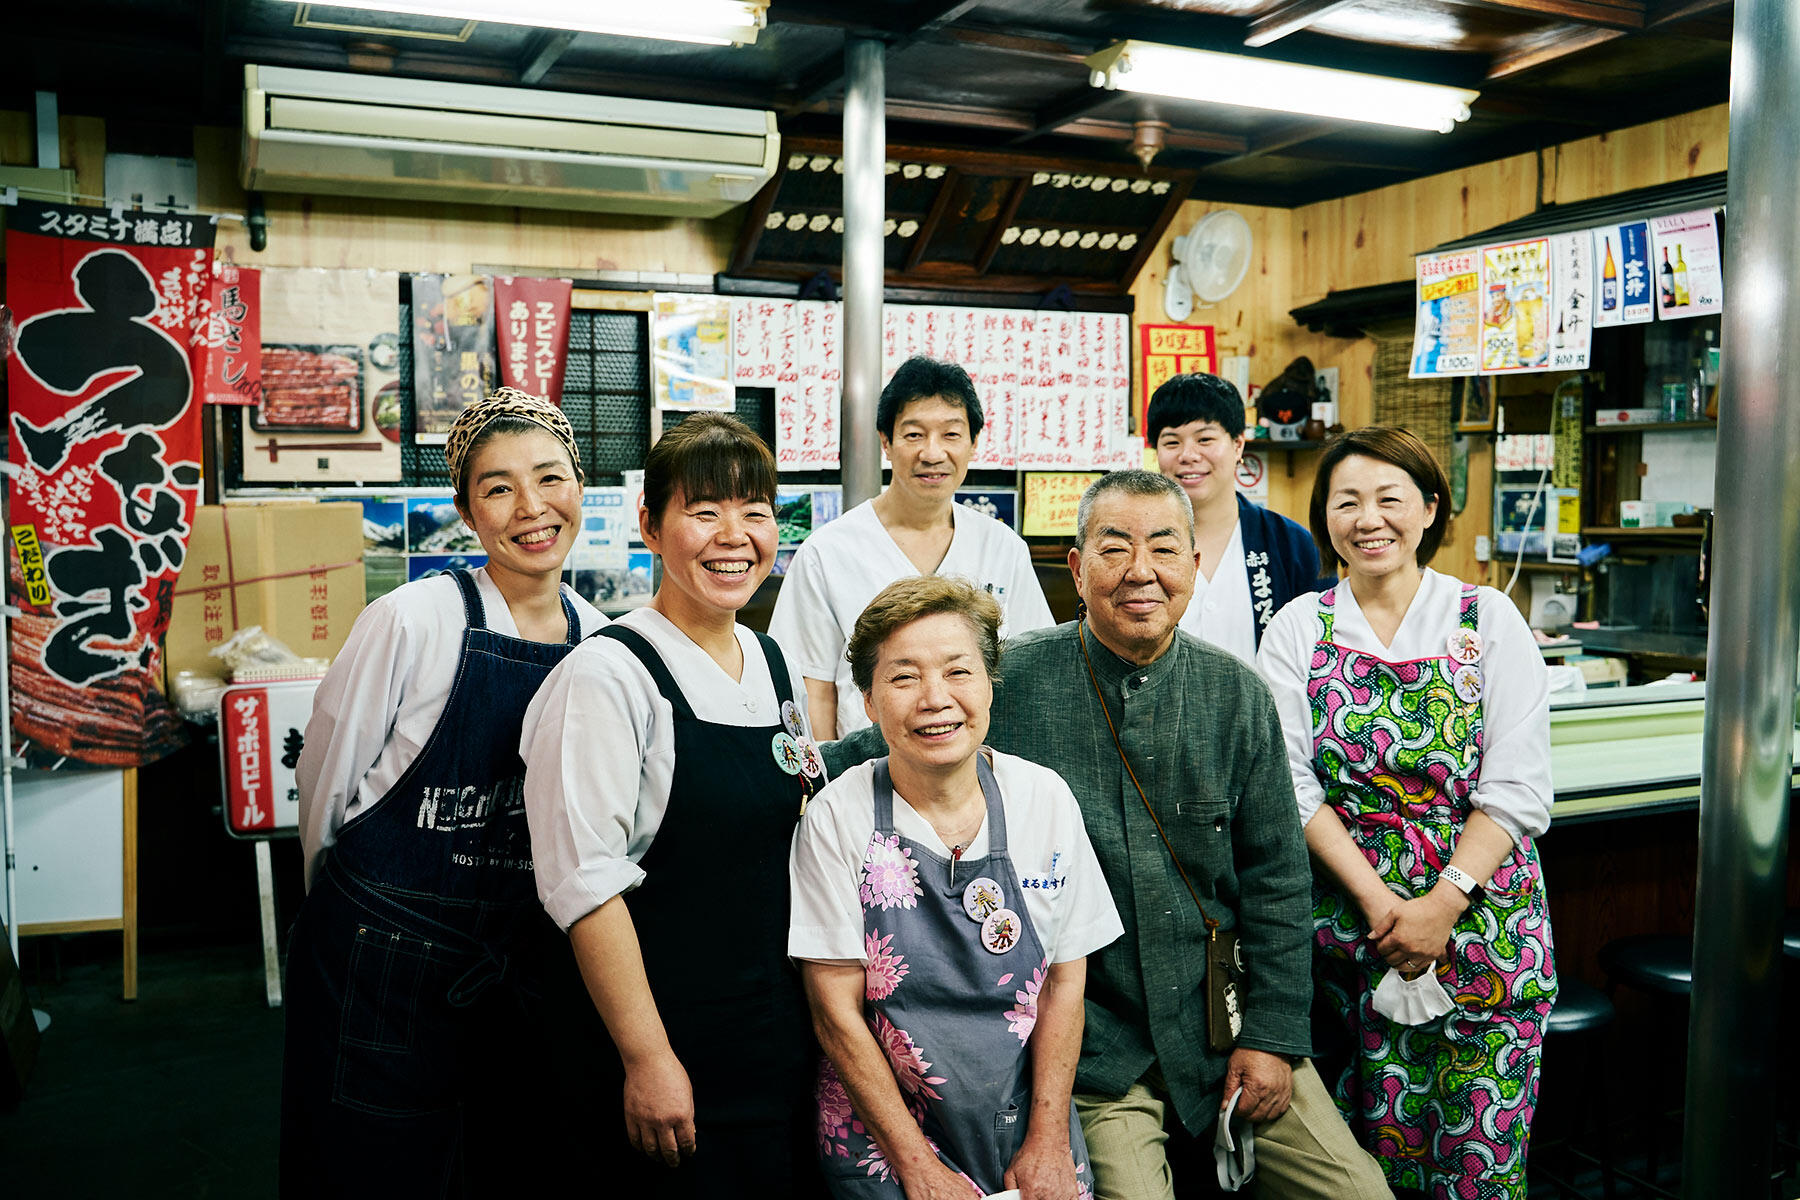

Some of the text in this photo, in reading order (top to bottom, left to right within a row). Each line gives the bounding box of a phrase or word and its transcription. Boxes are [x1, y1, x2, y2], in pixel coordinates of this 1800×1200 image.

[40, 211, 193, 246] スタミナ満点!
[509, 300, 530, 387] あります。
[16, 529, 47, 602] こだわり
[234, 696, 266, 827] サッポロビール
[1021, 876, 1066, 890] まるます
